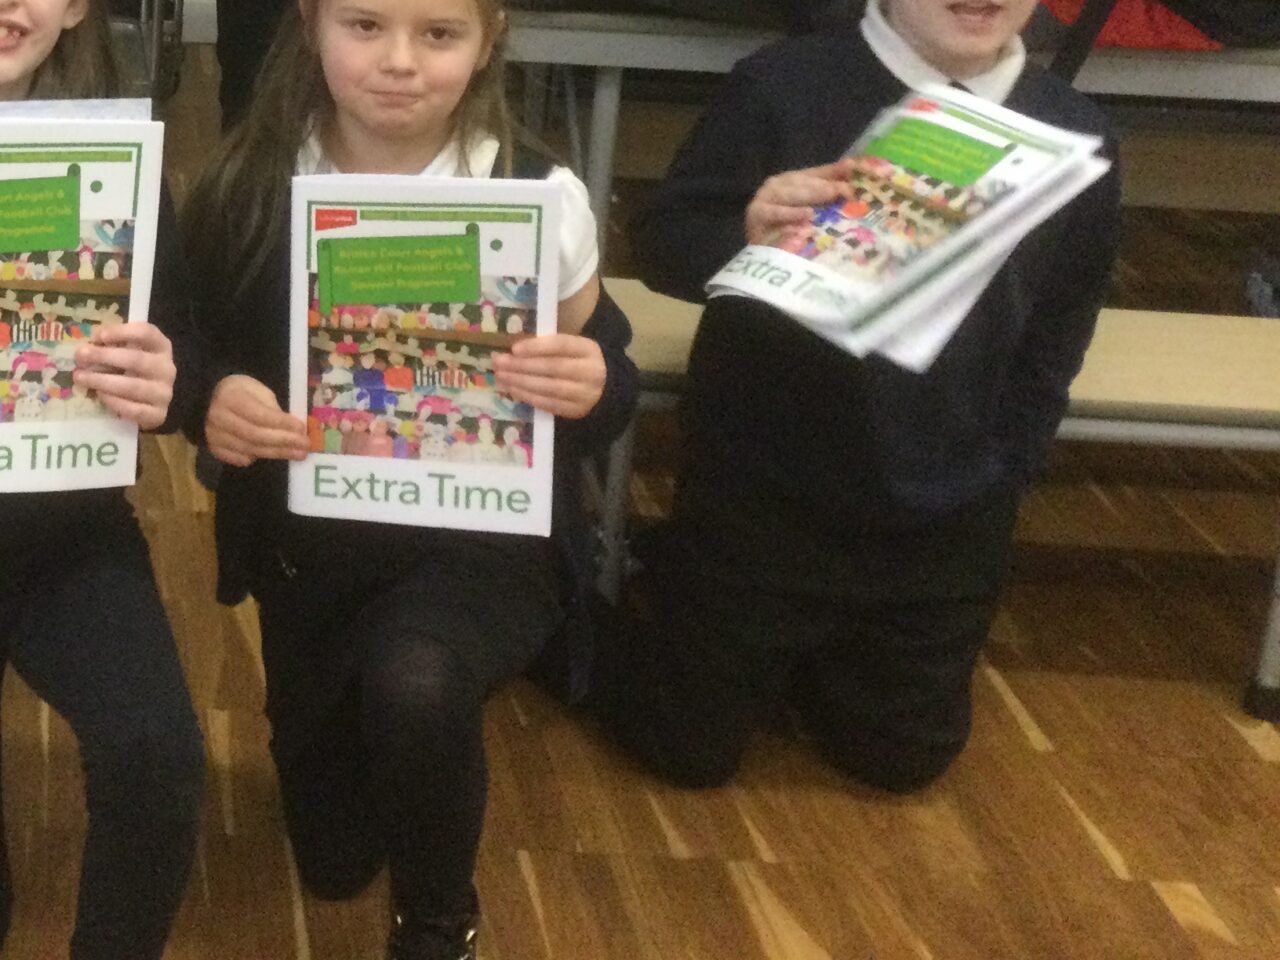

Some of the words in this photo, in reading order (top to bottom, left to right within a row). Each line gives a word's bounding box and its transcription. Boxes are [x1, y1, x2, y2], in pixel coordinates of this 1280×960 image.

[46, 206, 72, 216] Club
[20, 434, 119, 470] Time
[314, 464, 420, 505] Extra
[427, 472, 532, 514] Time
